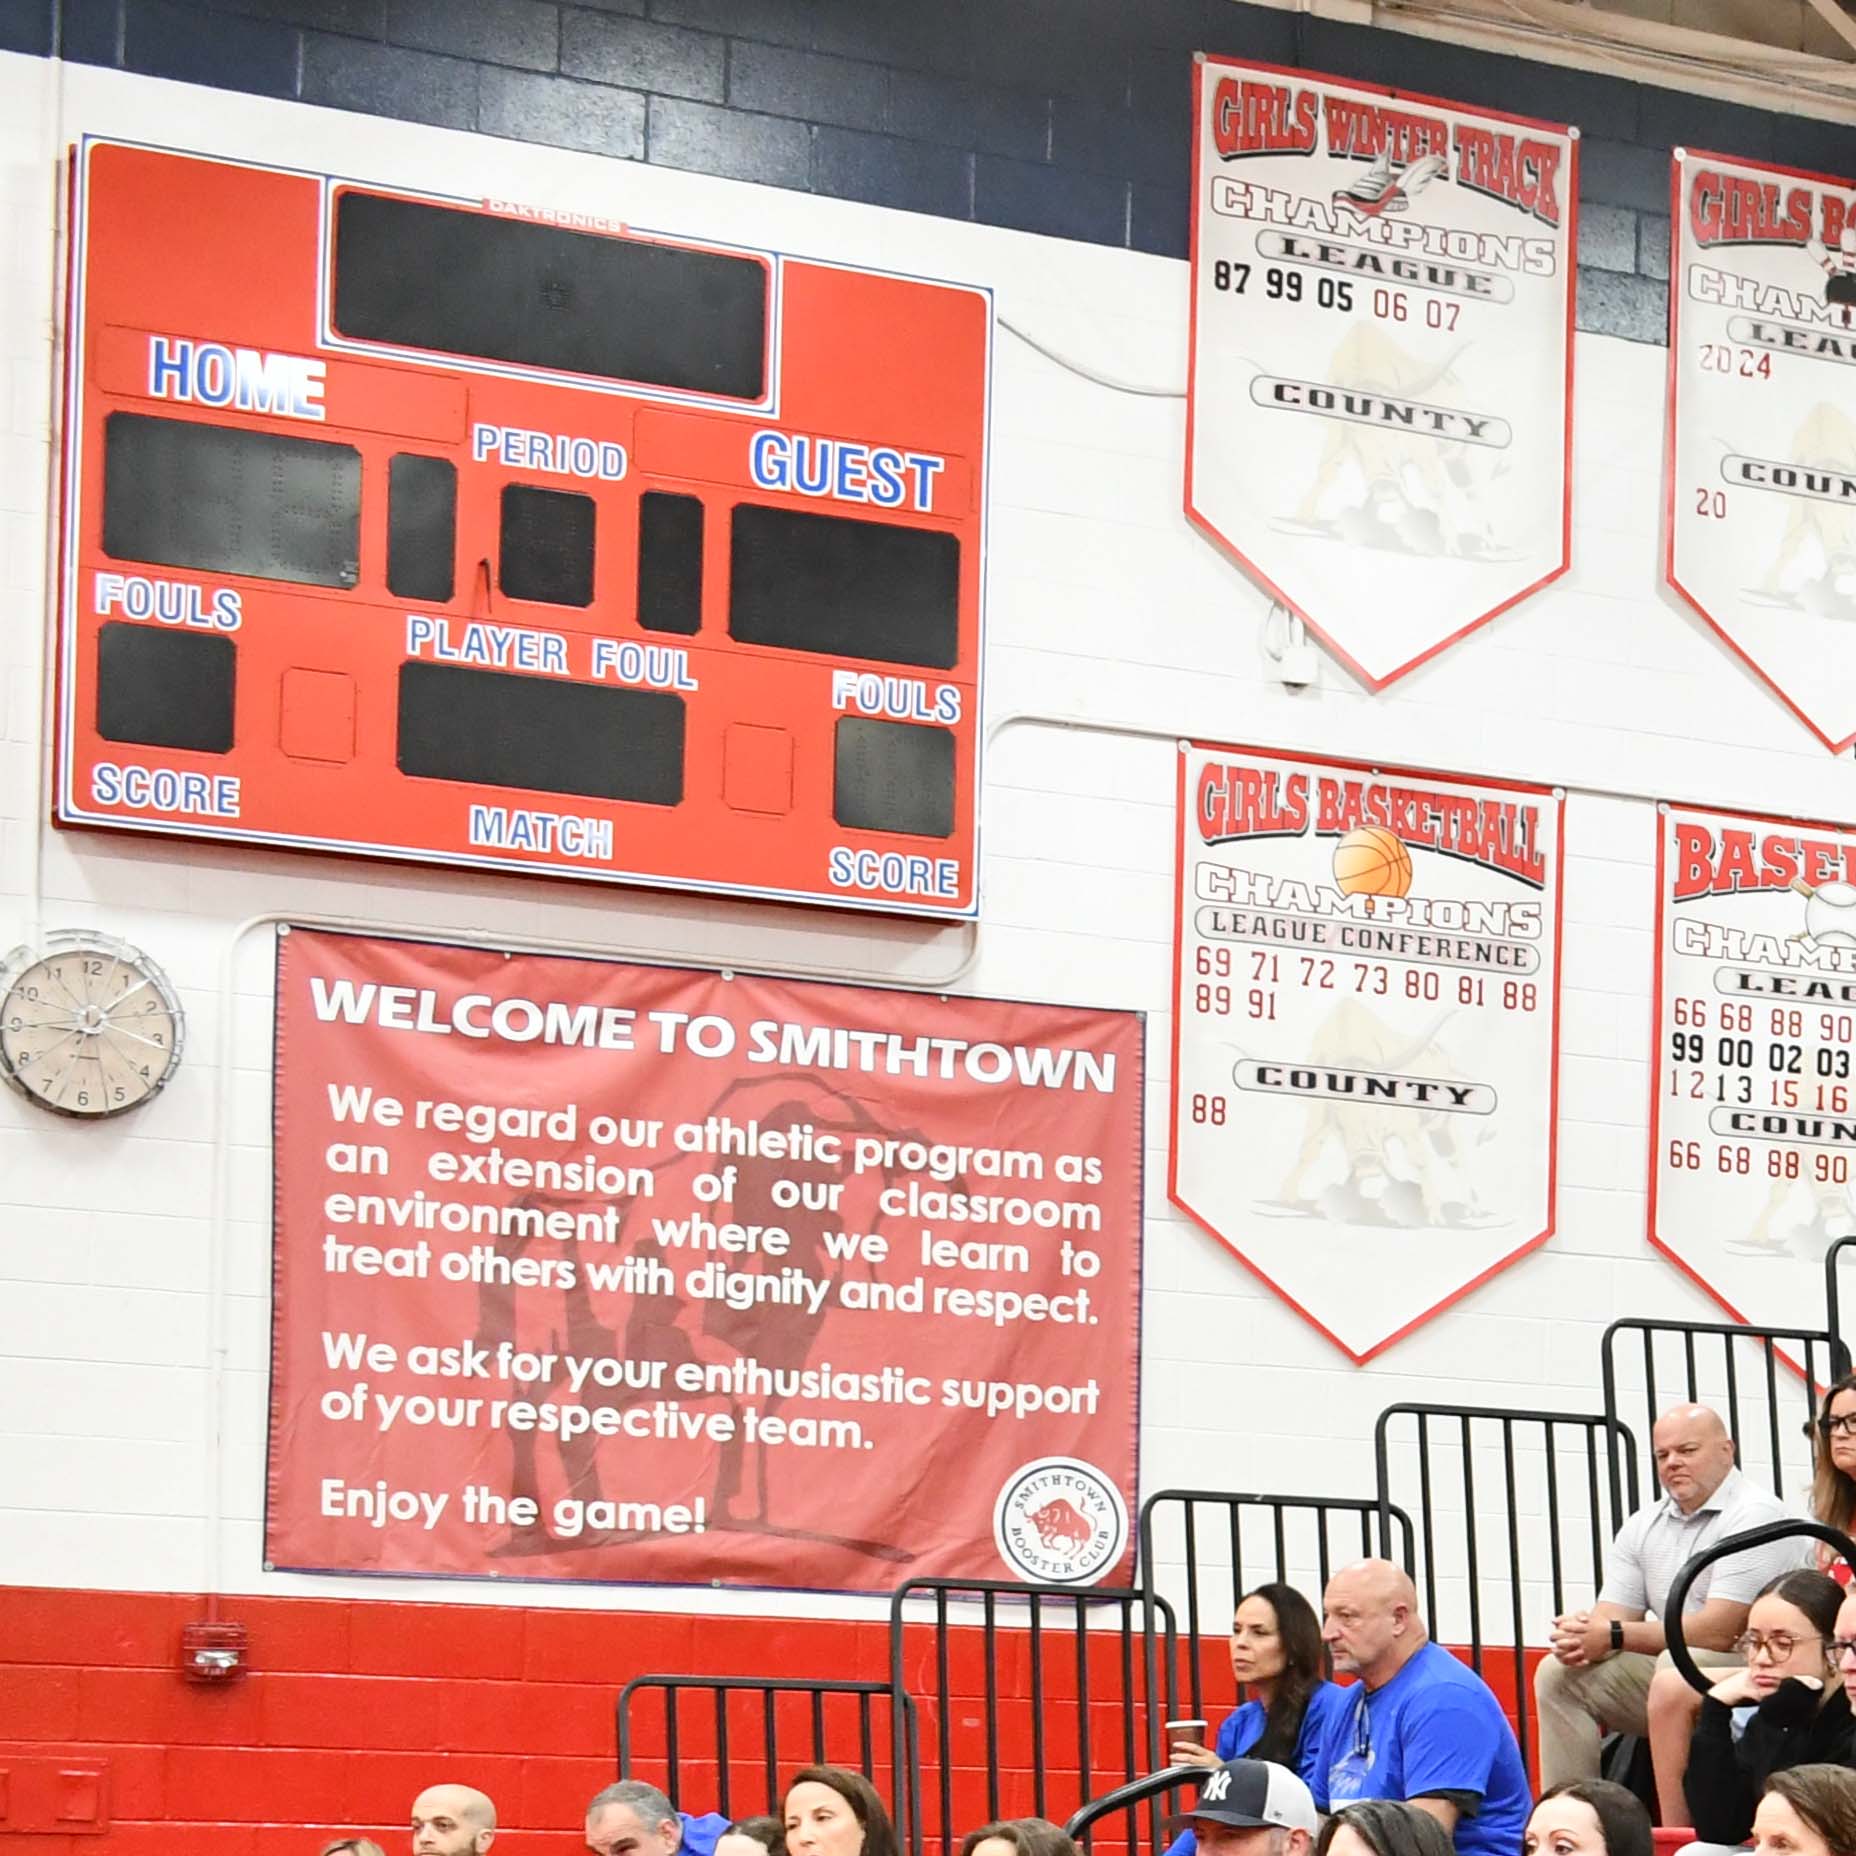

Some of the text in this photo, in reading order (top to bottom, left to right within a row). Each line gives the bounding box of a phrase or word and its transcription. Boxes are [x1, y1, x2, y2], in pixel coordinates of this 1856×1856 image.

[1213, 77, 1560, 229] GIRLS WINTER TRACK
[488, 199, 624, 233] DAKTRONICS
[1211, 174, 1556, 277] CHAMPIONS
[1690, 169, 1813, 248] GIRLS
[1215, 260, 1461, 333] 87 99 05 06 07
[1280, 237, 1492, 295] LEAGUE
[149, 336, 326, 420] HOME
[1739, 349, 1771, 381] 24
[1274, 381, 1490, 438] COUNTY
[473, 424, 628, 480] PERIOD
[750, 431, 944, 510] GUEST
[1697, 489, 1726, 518] 20
[94, 574, 241, 630] FOULS
[407, 619, 697, 691] PLAYER FOUL
[832, 672, 962, 724] FOULS
[92, 765, 240, 818] SCORE
[468, 808, 614, 858] MATCH
[1199, 762, 1546, 891] GIRLS BASKETBALL
[828, 847, 959, 898] SCORE
[1195, 862, 1542, 940] CHAMPIONS
[1212, 911, 1528, 969] LEAGUE CONFERENCE
[1196, 947, 1536, 1011] 69 71 72 73 80 81 88
[1196, 984, 1277, 1021] 89 91
[309, 976, 1116, 1093] WELCOME TO SMITHTOWN
[1192, 1095, 1226, 1126] 88
[1255, 1066, 1475, 1106] COUNTY
[327, 1083, 1103, 1186] We regard our athletic program as
[325, 1140, 1101, 1232] an extension of our classroom
[325, 1189, 1101, 1279] environment where we learn to
[323, 1236, 1099, 1327] treat others with dignity and respect.
[322, 1332, 1101, 1419] We ask for your enthusiastic support
[321, 1385, 874, 1452] of your respective team.
[320, 1478, 708, 1539] Enjoy the game!
[1015, 1474, 1107, 1512] SMITHTOWN
[1011, 1527, 1109, 1573] BOOSTER CLUB
